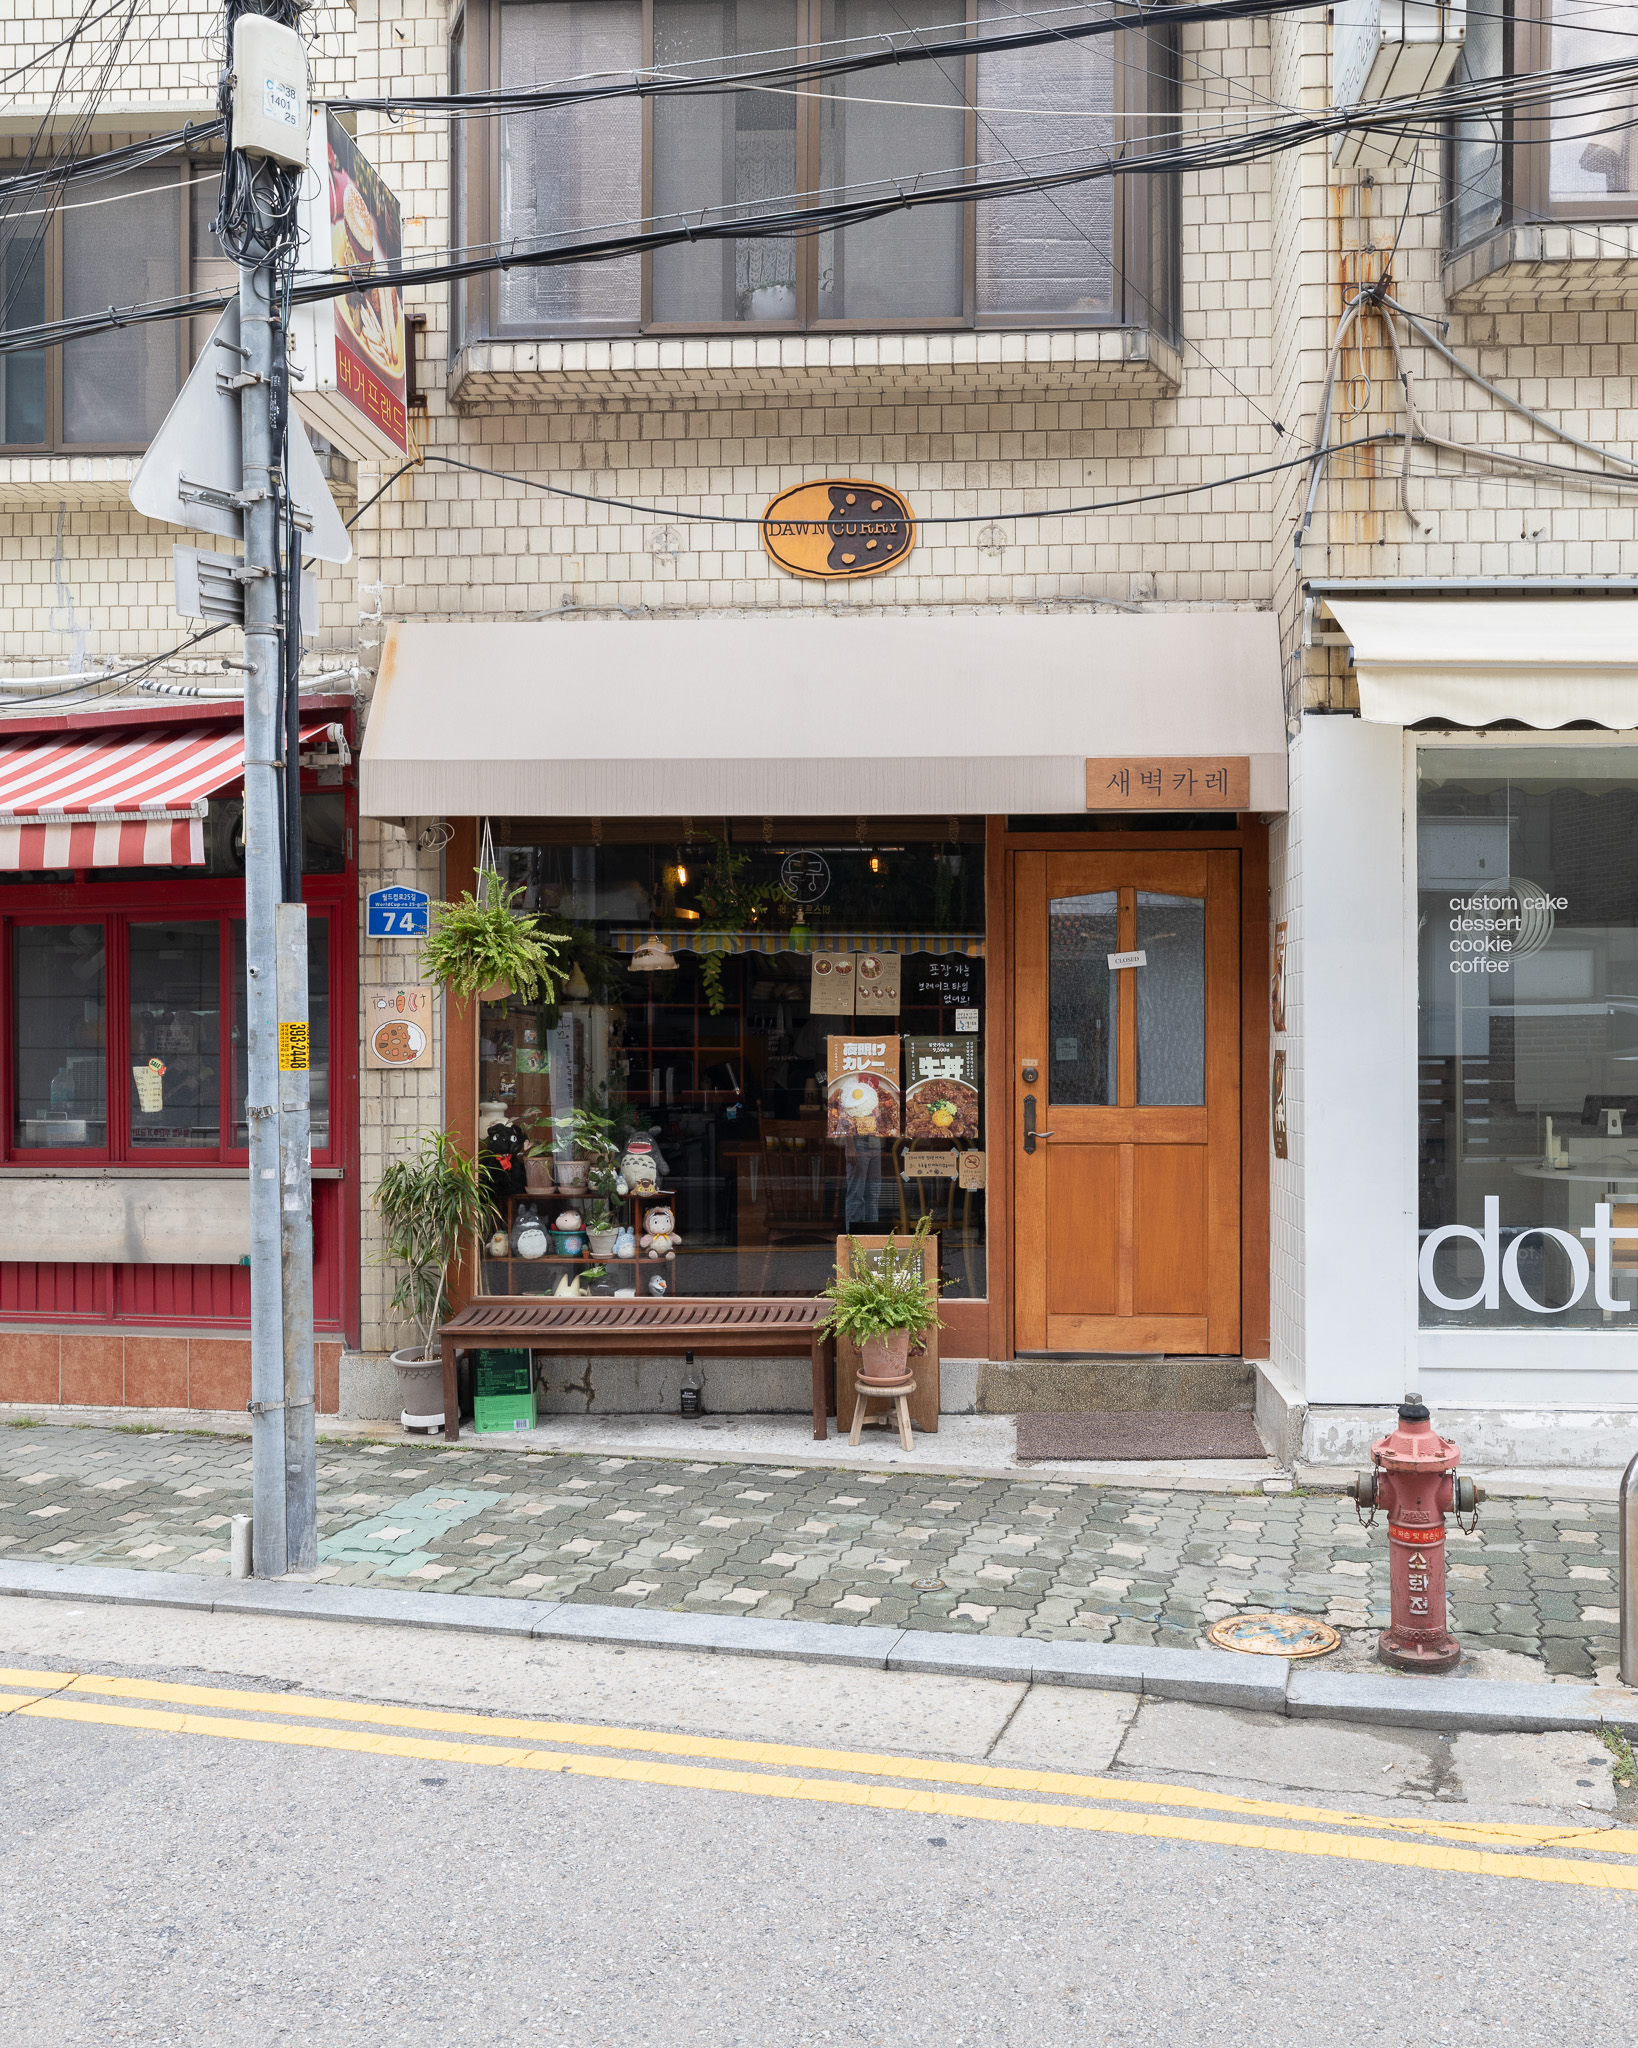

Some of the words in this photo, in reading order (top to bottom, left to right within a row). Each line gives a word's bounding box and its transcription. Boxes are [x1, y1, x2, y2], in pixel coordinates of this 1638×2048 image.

[270, 94, 291, 110] 1401
[285, 112, 296, 125] 25
[339, 350, 405, 440] 버거프랜드
[769, 521, 825, 537] DAWN
[832, 519, 898, 536] CURRY
[1106, 767, 1228, 797] 새벽카레
[382, 893, 416, 902] 월드컵로25길
[1449, 894, 1518, 911] custom
[1522, 893, 1568, 911] cake
[382, 912, 415, 932] 74
[1449, 915, 1522, 932] dessert
[1449, 935, 1513, 953] cookie
[1114, 956, 1140, 964] CLOSED
[1449, 956, 1510, 973] coffee
[929, 963, 952, 977] 포장
[954, 964, 970, 977] 가능
[842, 1042, 887, 1056] 夜明け
[842, 1056, 886, 1071] カレー
[918, 1055, 965, 1080] 牛丼
[1418, 1195, 1638, 1313] dot
[1408, 1552, 1429, 1615] 소화전
